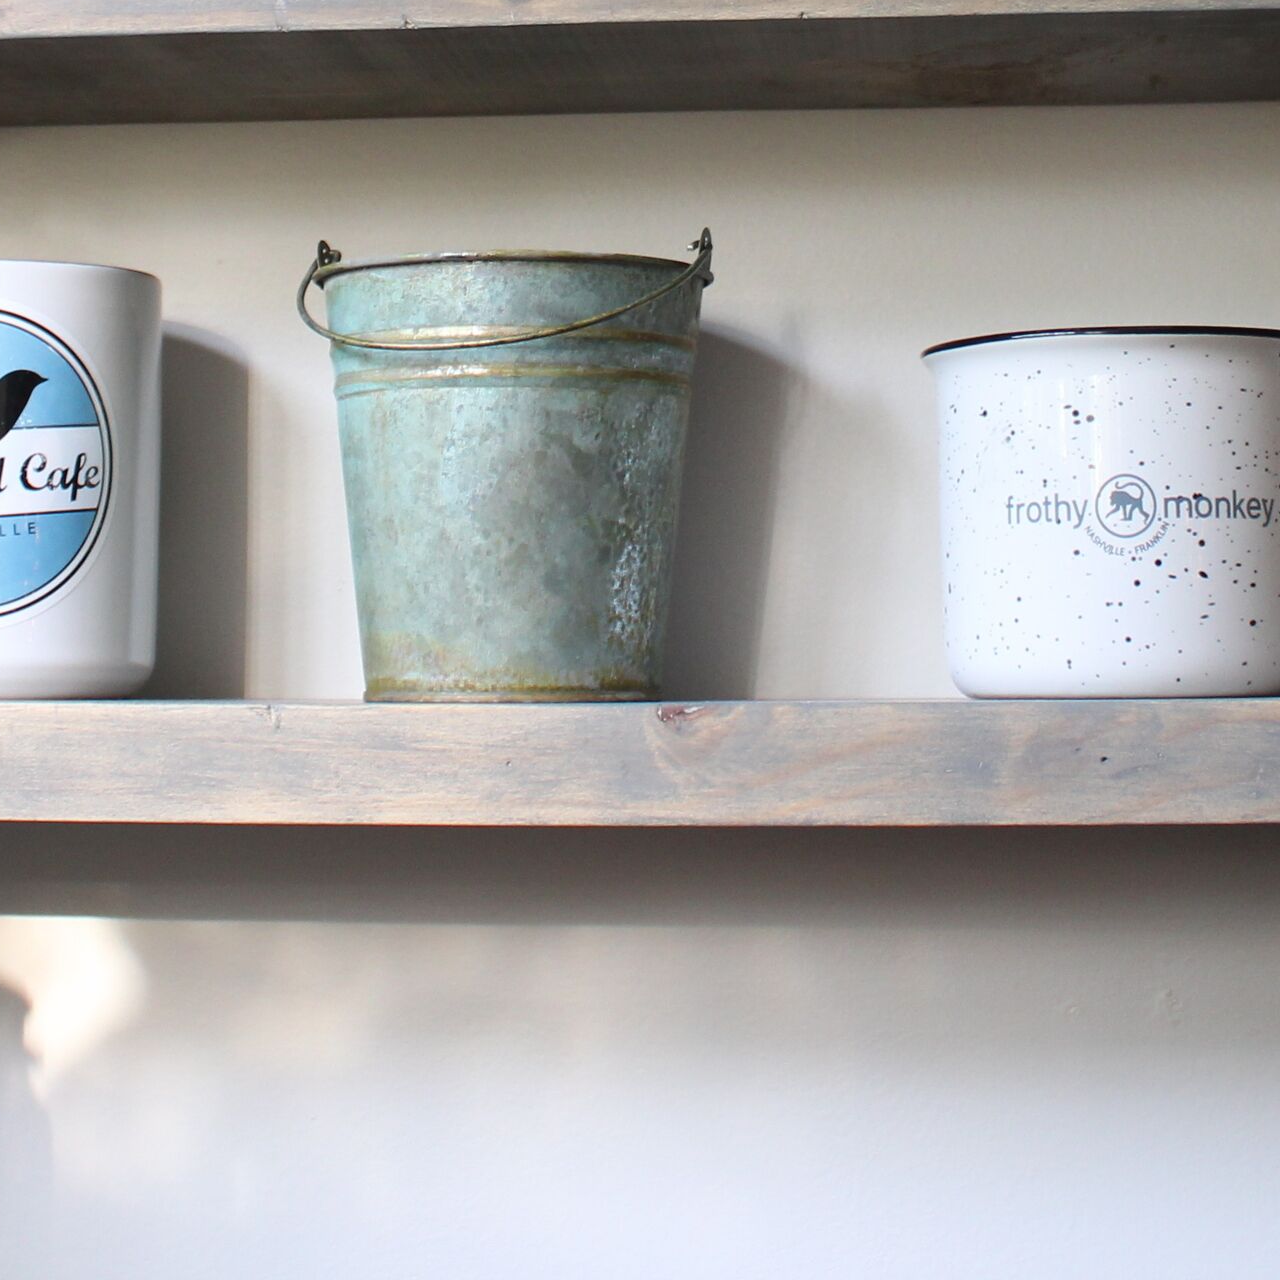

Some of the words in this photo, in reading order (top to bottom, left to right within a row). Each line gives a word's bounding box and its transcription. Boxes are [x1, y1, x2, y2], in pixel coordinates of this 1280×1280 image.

[20, 452, 101, 502] Cafe
[1006, 492, 1088, 529] frothy
[1163, 489, 1274, 528] monkey
[1085, 525, 1126, 557] NASHVILLE
[1134, 520, 1171, 555] FRANKLIN
